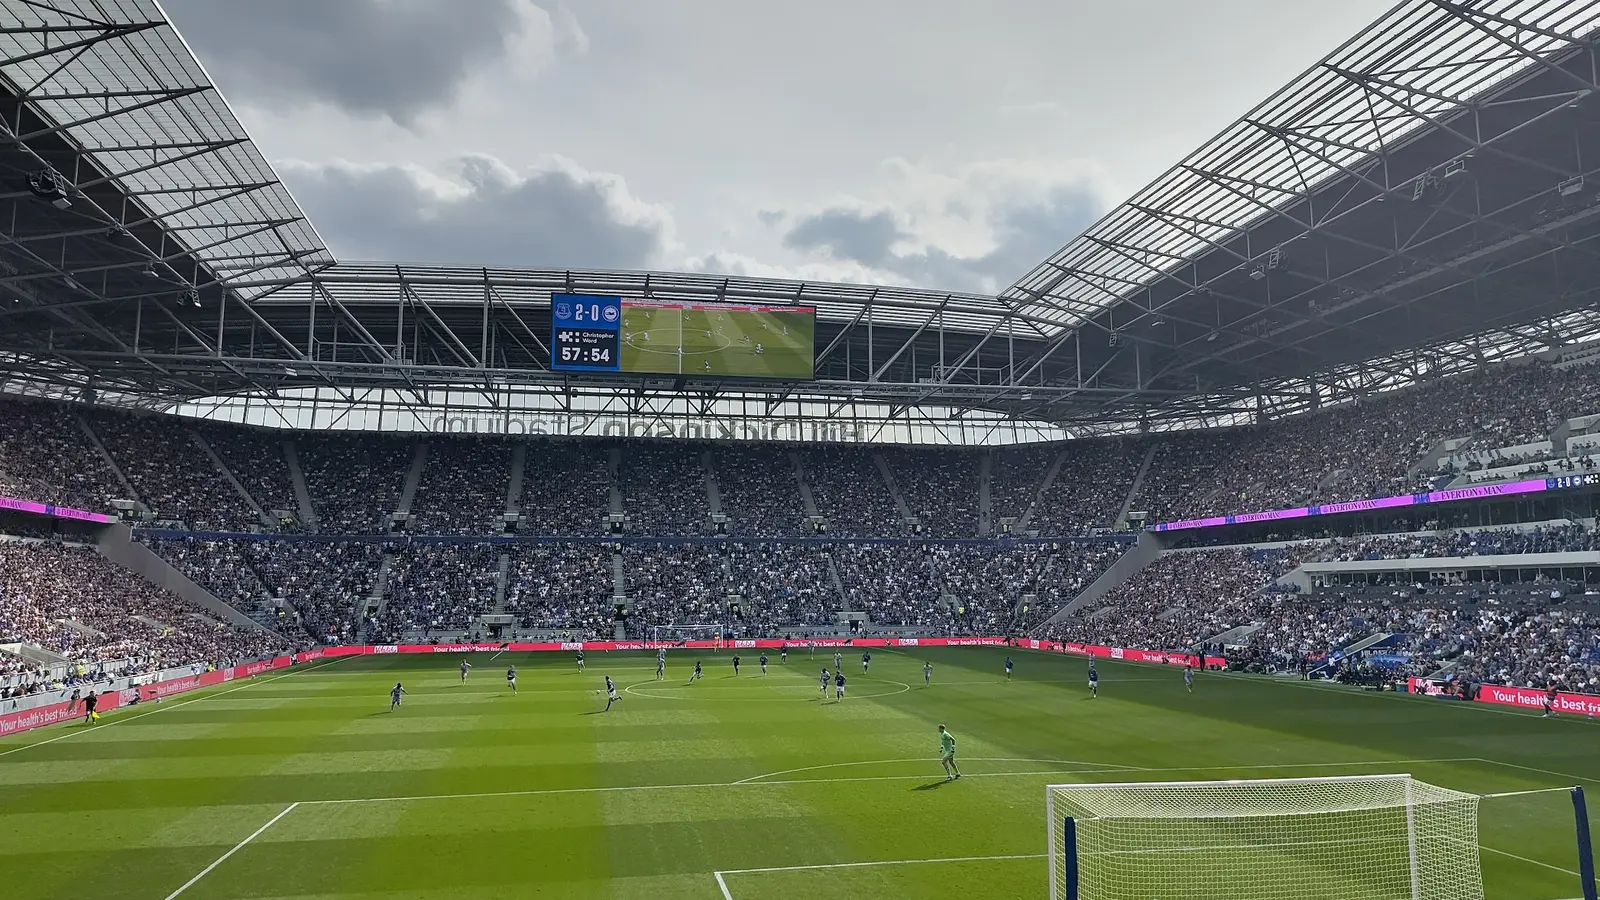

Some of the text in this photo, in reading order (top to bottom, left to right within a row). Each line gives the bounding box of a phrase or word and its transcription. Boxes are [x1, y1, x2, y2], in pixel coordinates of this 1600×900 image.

[575, 303, 599, 321] 2-0
[561, 347, 610, 362] 57:54
[1441, 488, 1478, 500] EVERTON
[1329, 502, 1358, 512] EVERTON
[1242, 513, 1264, 522] EVERTON
[1493, 690, 1516, 701] Your
[1517, 692, 1559, 708] healts
[1561, 697, 1585, 711] best
[0, 719, 16, 732] Your
[17, 712, 44, 728] health's
[44, 709, 58, 721] best
